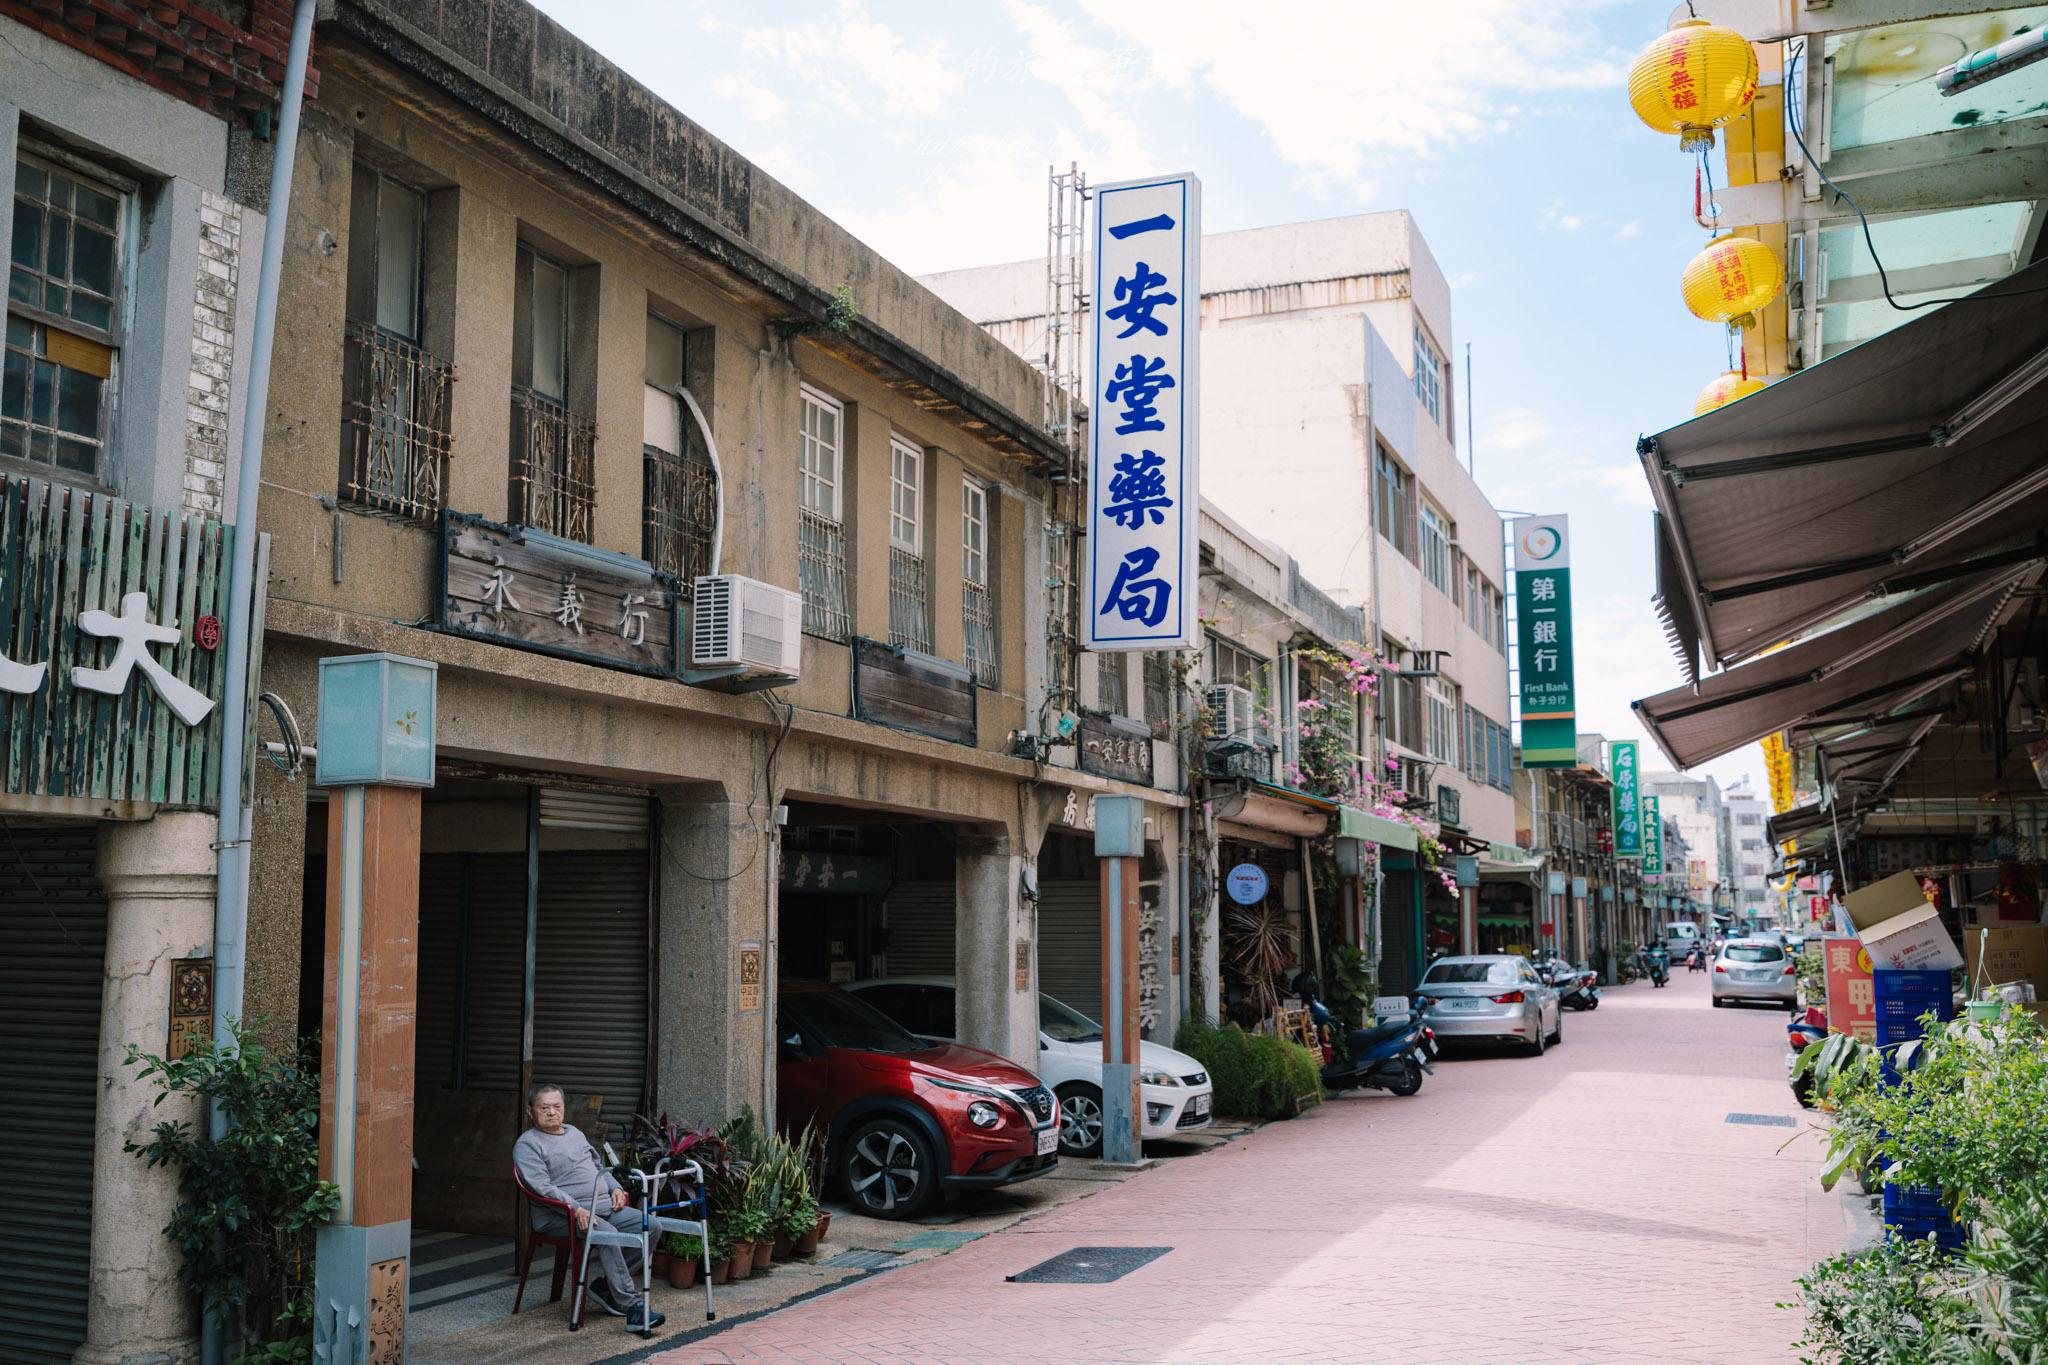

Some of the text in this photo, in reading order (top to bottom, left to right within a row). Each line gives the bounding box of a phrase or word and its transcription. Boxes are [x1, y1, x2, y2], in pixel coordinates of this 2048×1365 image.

[1099, 212, 1177, 628] 一安堂藥局
[480, 554, 650, 646] 永義行
[1531, 577, 1559, 673] 第一銀行
[1524, 682, 1569, 693] First Bank
[1615, 746, 1638, 835] 石原藥局
